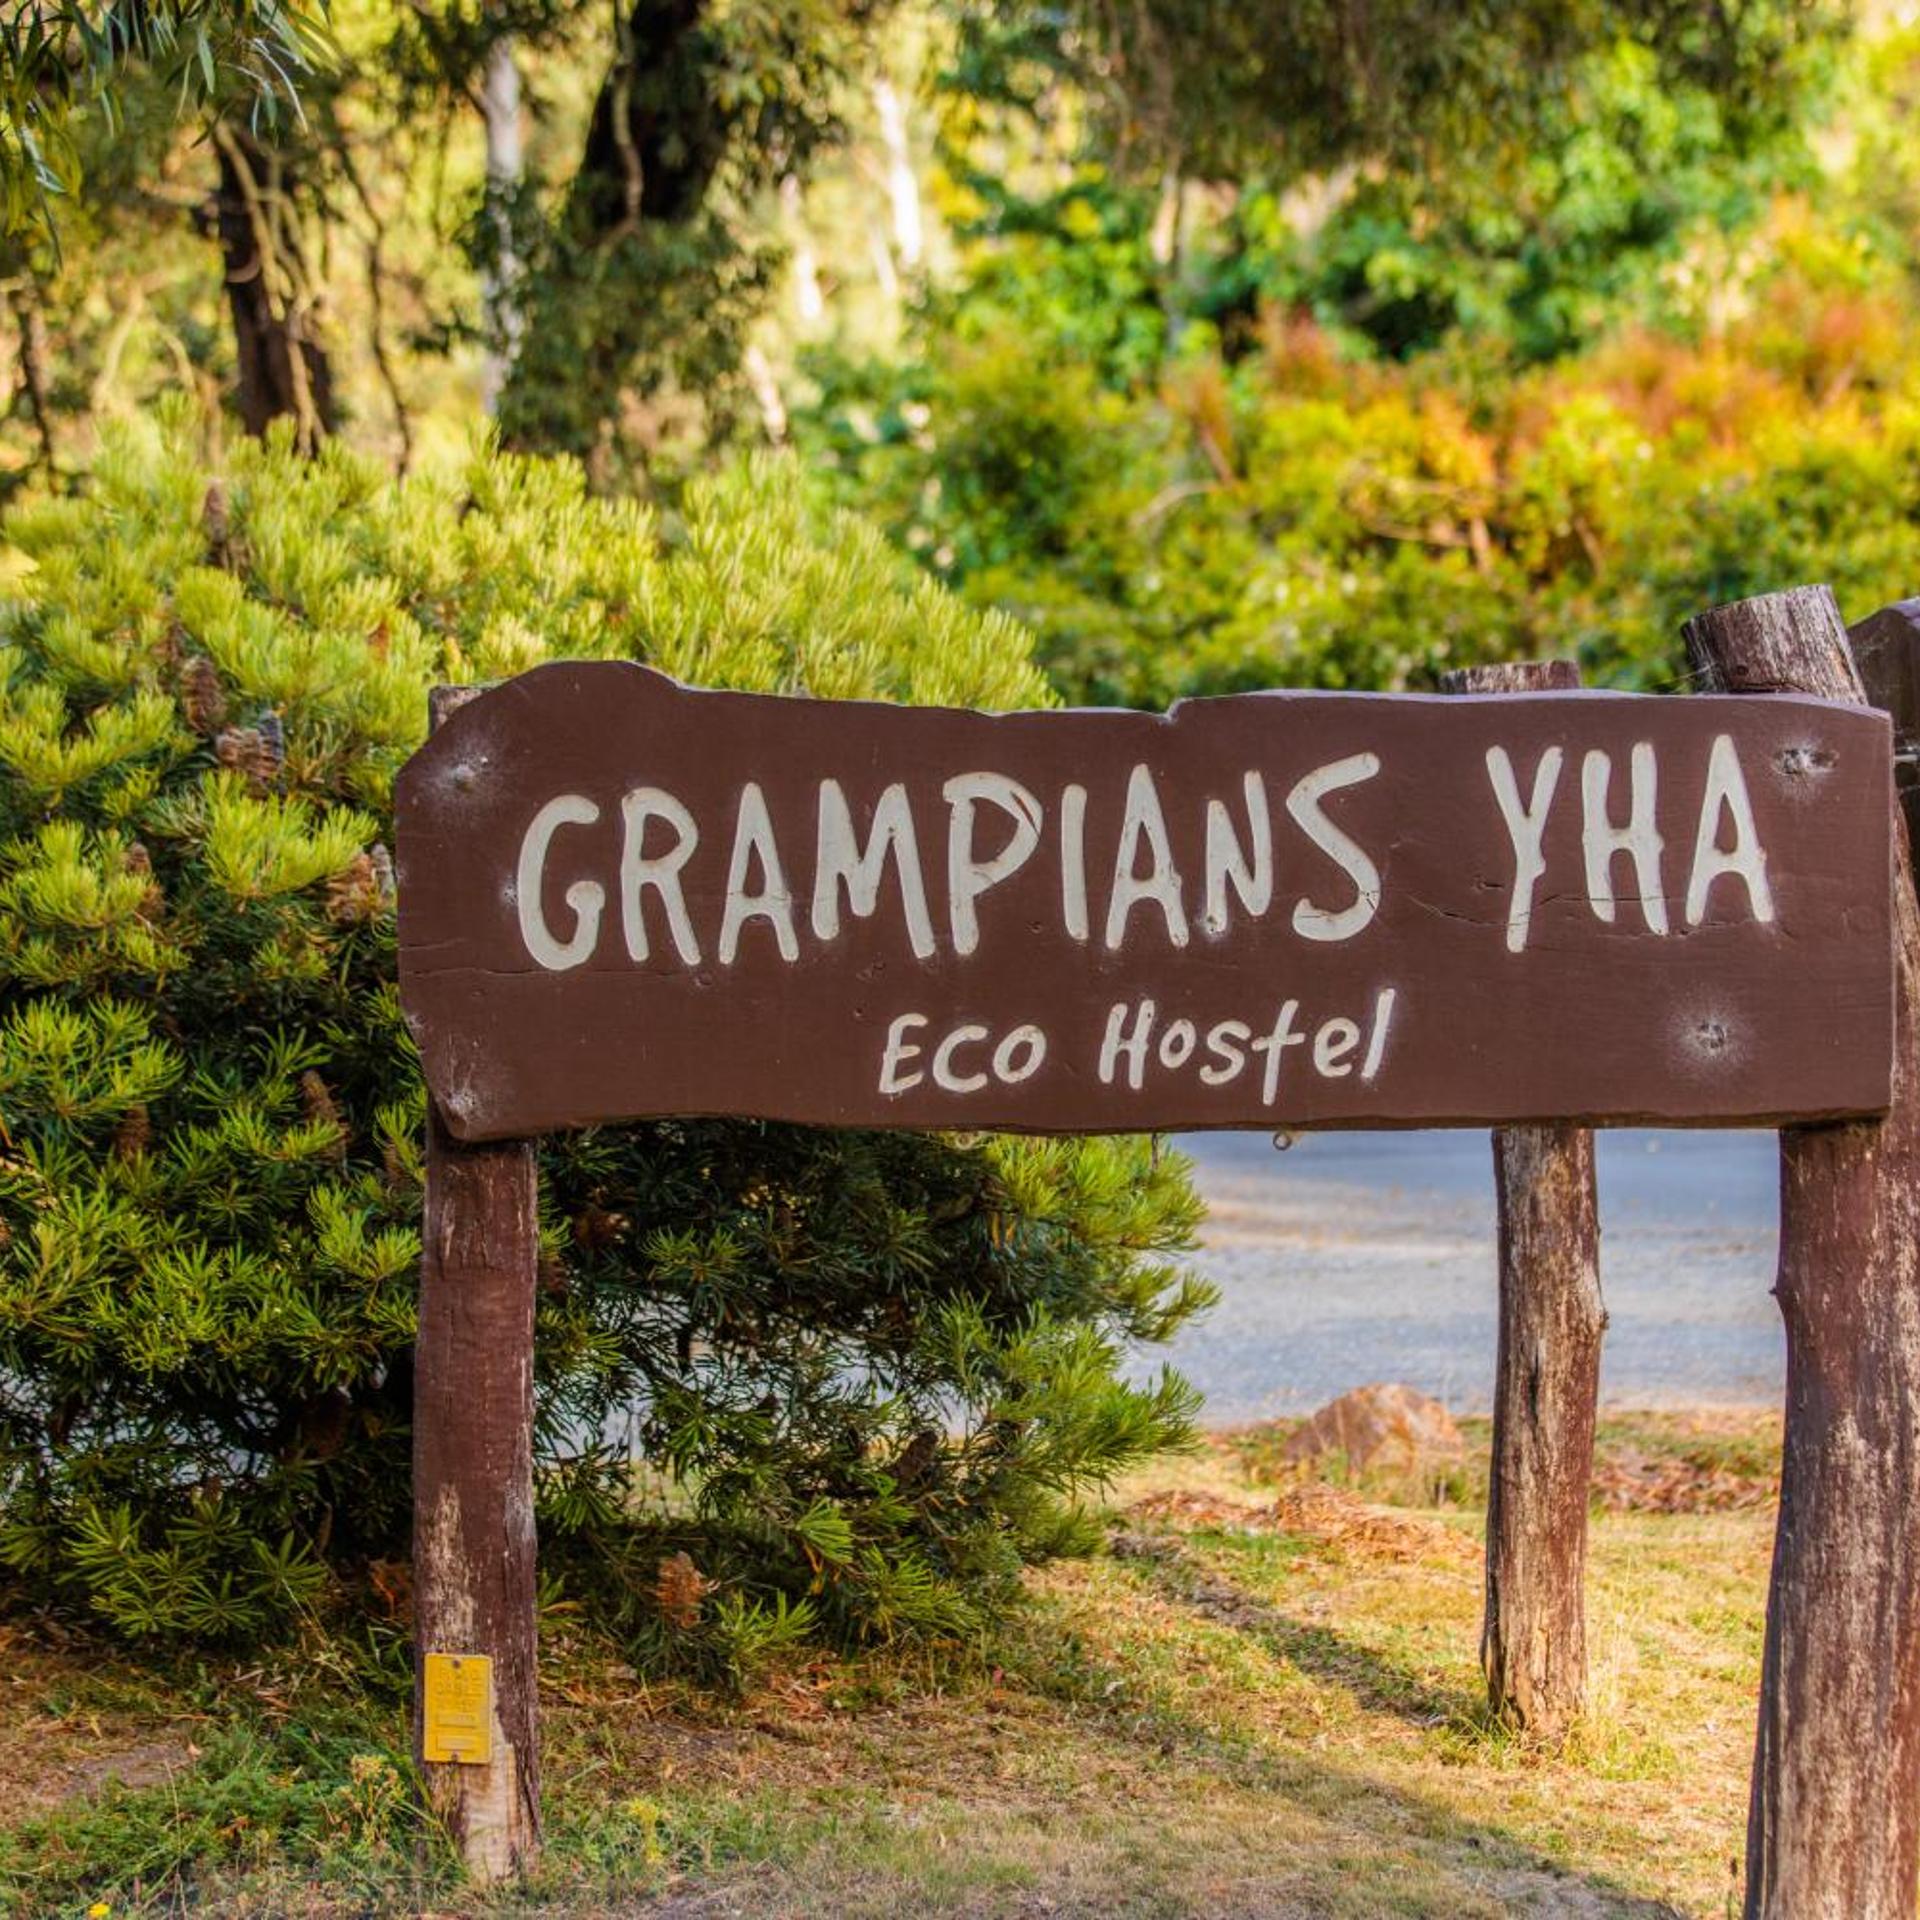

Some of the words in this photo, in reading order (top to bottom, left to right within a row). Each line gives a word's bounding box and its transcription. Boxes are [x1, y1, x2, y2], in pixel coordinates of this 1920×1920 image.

[516, 752, 1382, 971] GRAMPIANS
[1485, 733, 1776, 953] YHA
[1097, 988, 1397, 1107] Hostel
